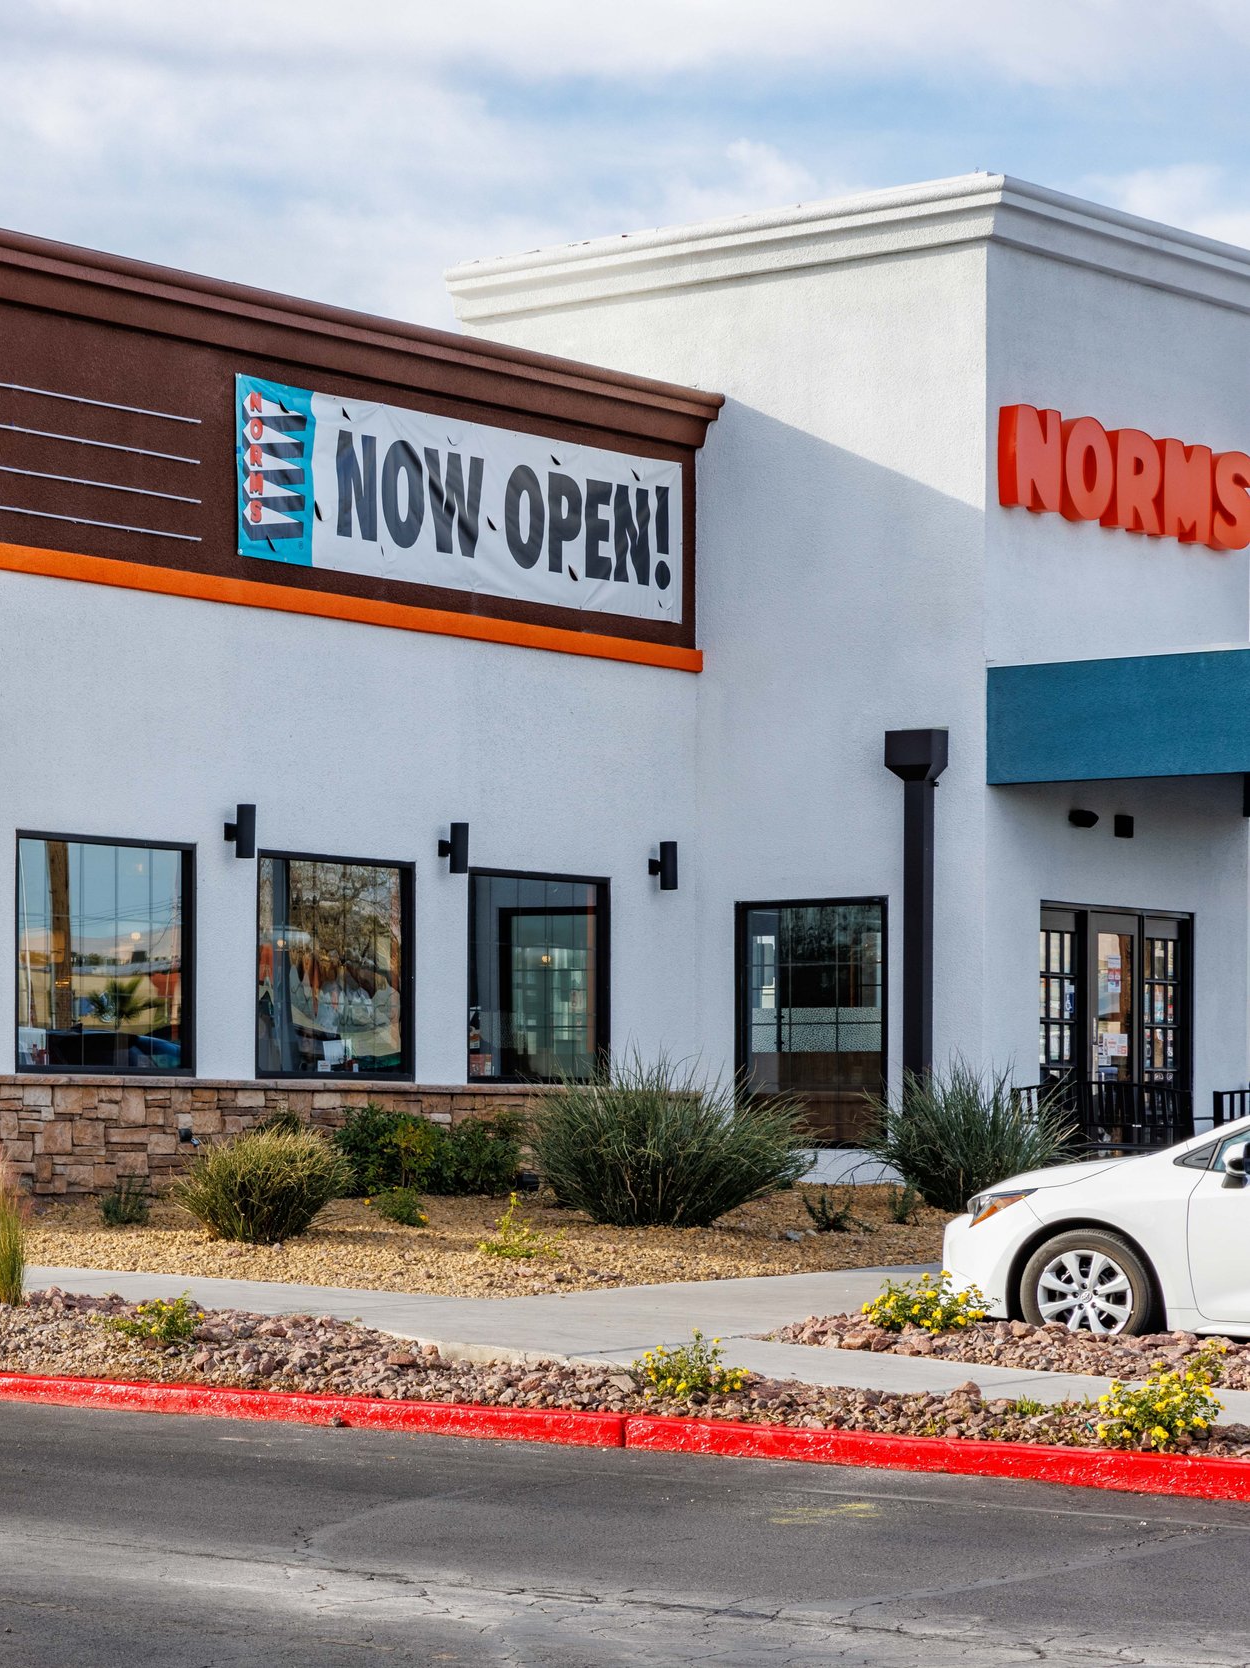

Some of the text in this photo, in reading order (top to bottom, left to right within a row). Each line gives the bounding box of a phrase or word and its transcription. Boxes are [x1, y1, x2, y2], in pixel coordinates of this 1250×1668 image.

[249, 392, 264, 524] NORMS
[336, 429, 672, 592] NOW OPEN!
[998, 404, 1250, 550] NORMS
